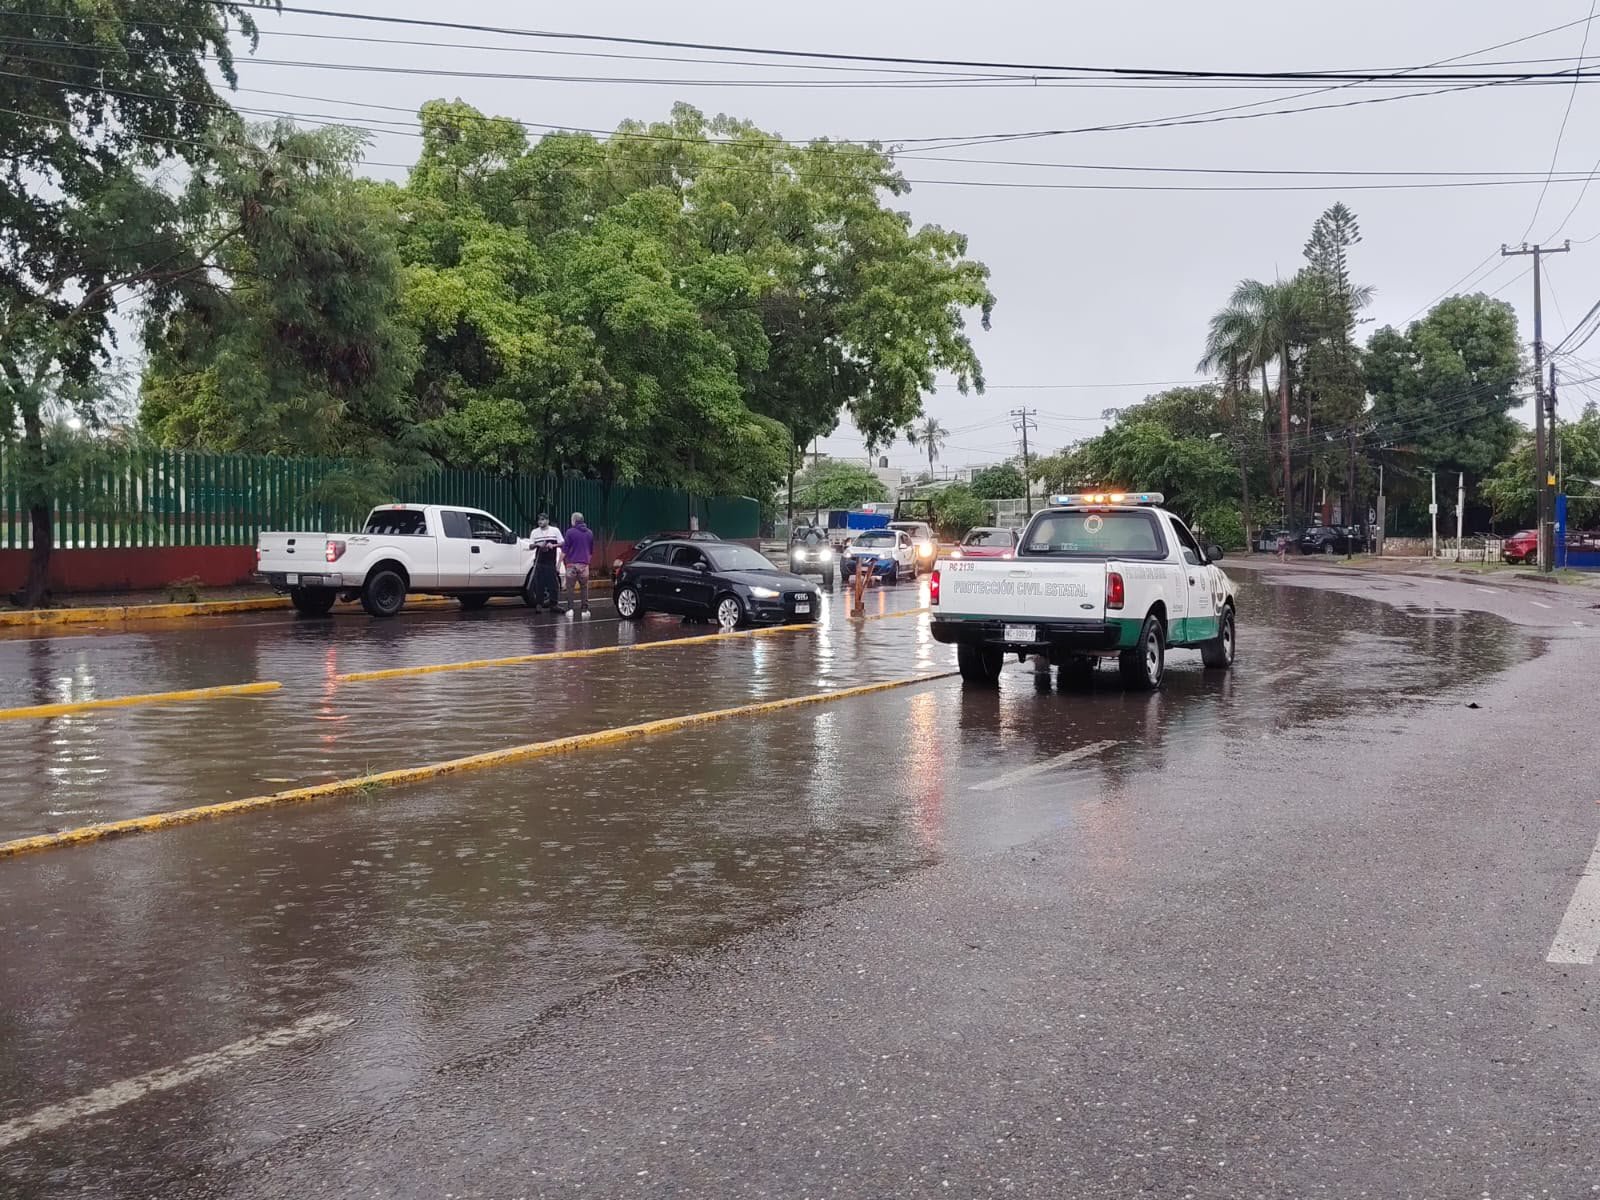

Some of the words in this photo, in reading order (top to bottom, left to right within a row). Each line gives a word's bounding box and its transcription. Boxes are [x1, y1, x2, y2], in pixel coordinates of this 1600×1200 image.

[949, 562, 958, 571] PC
[953, 579, 1014, 596] PROTECCIÓN
[1016, 582, 1042, 596] CIVIL
[1044, 582, 1088, 598] ESTATAL
